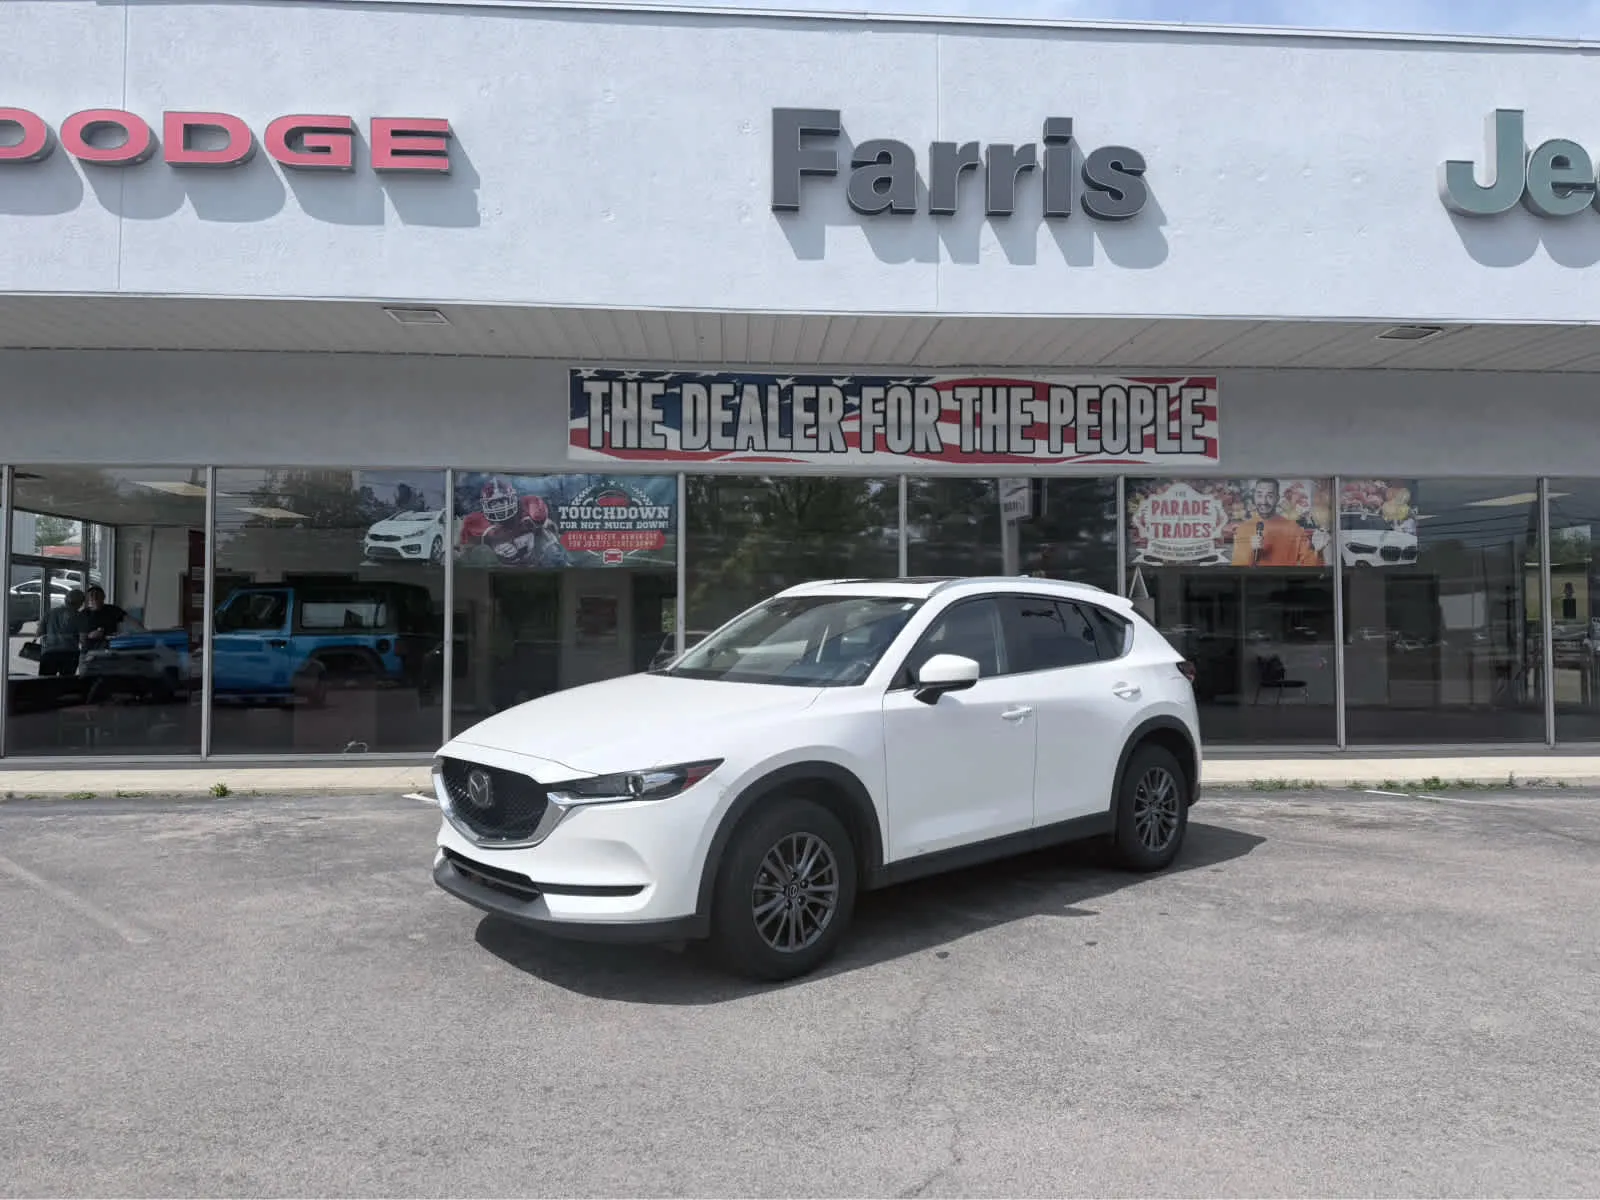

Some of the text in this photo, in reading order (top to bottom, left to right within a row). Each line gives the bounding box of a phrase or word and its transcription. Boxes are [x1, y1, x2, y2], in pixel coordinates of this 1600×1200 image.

[772, 107, 1148, 220] Farris
[1438, 108, 1600, 219] Je
[583, 379, 1208, 455] THE DEALER FOR THE PEOPLE
[558, 506, 670, 520] TOUCHDOWN
[1151, 500, 1211, 516] PARADE
[560, 521, 669, 529] FOR NOT MUCH DOWN!
[1151, 522, 1212, 539] TRADES
